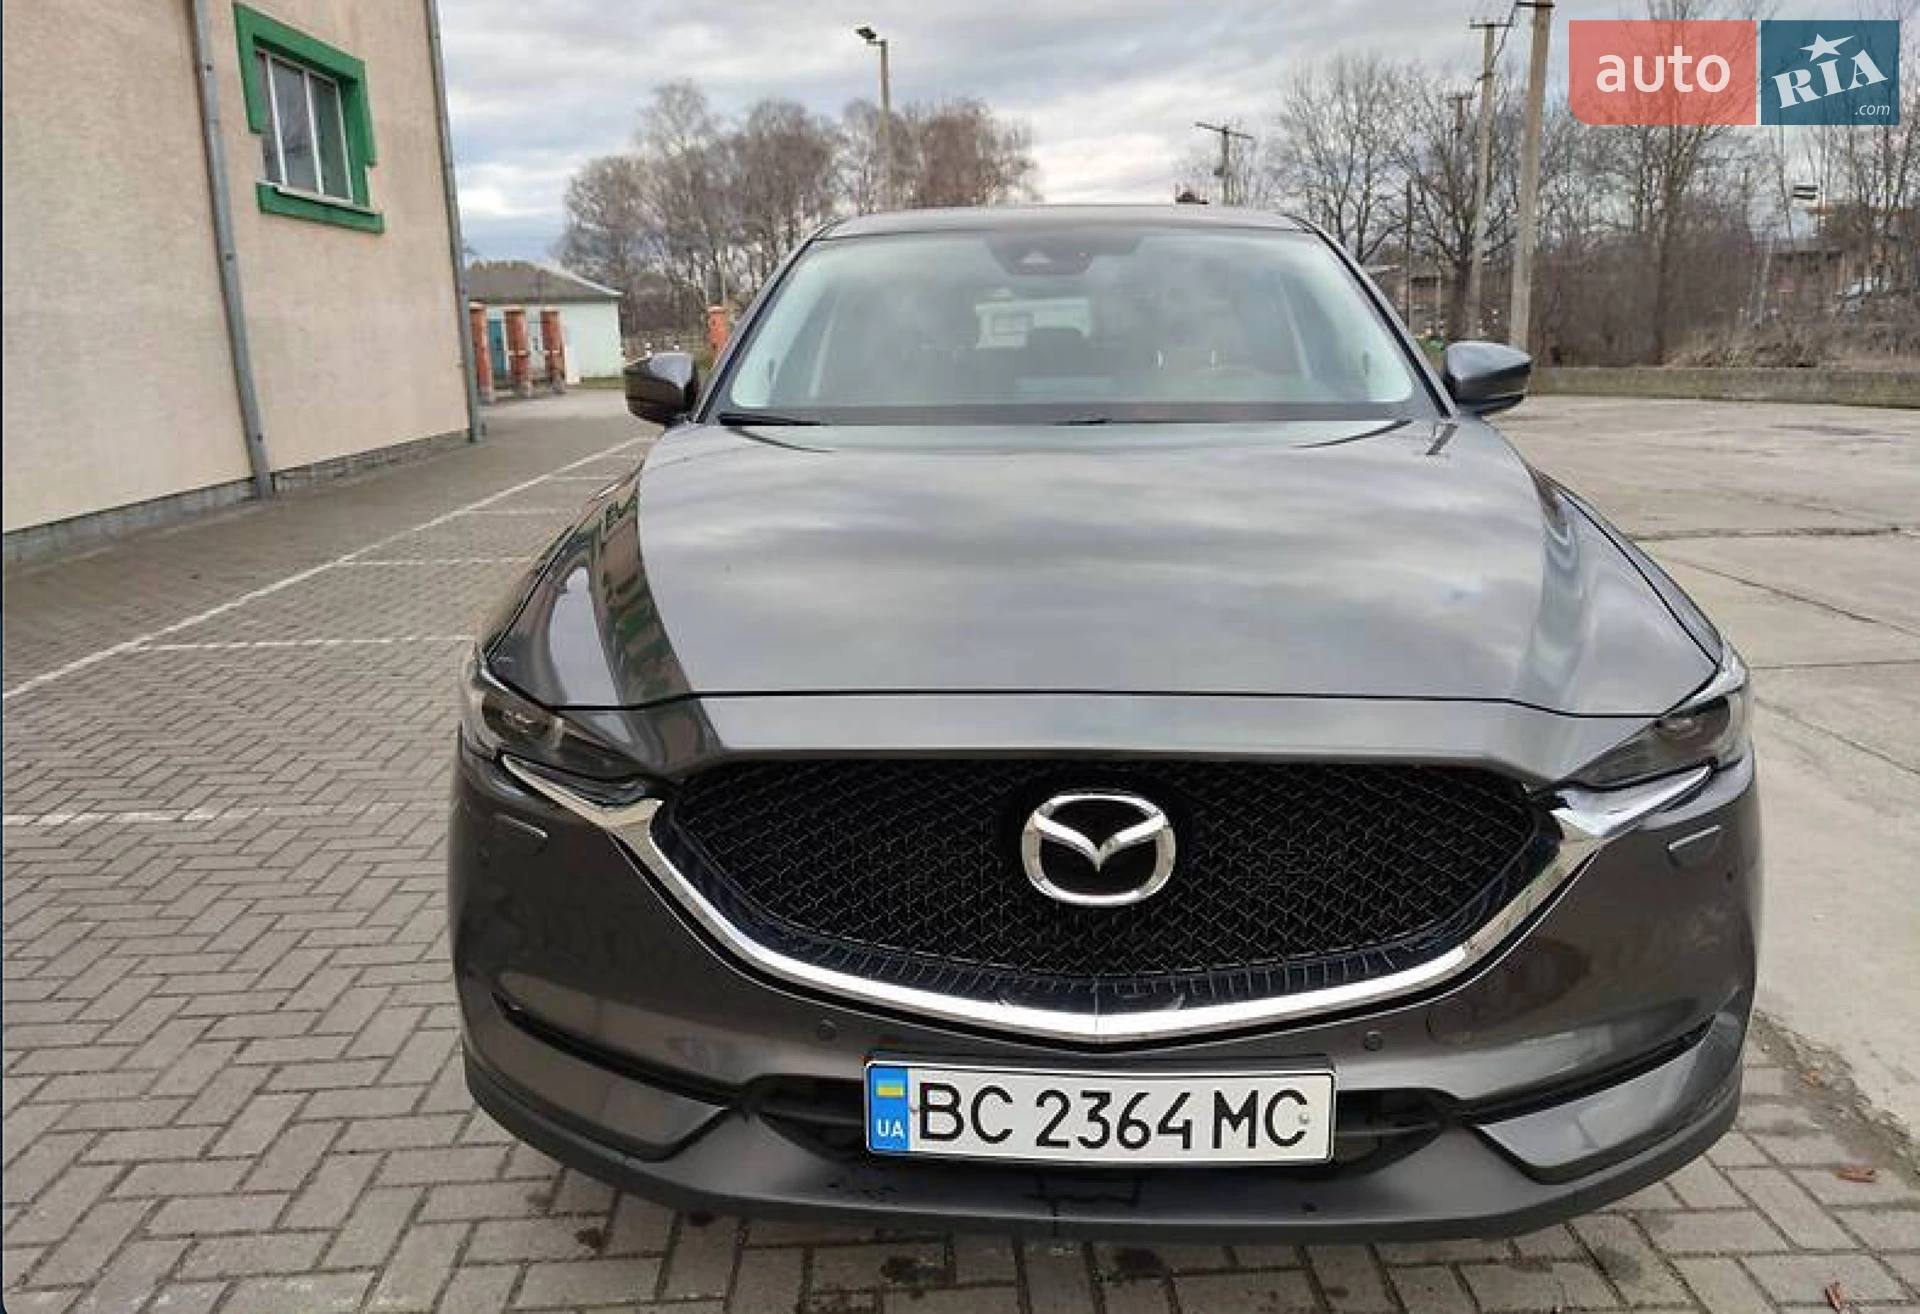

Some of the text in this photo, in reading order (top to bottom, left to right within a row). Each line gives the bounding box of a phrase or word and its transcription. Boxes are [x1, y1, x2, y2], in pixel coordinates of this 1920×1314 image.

[876, 1119, 905, 1138] UA
[919, 1082, 1308, 1150] BC 2364 MC
